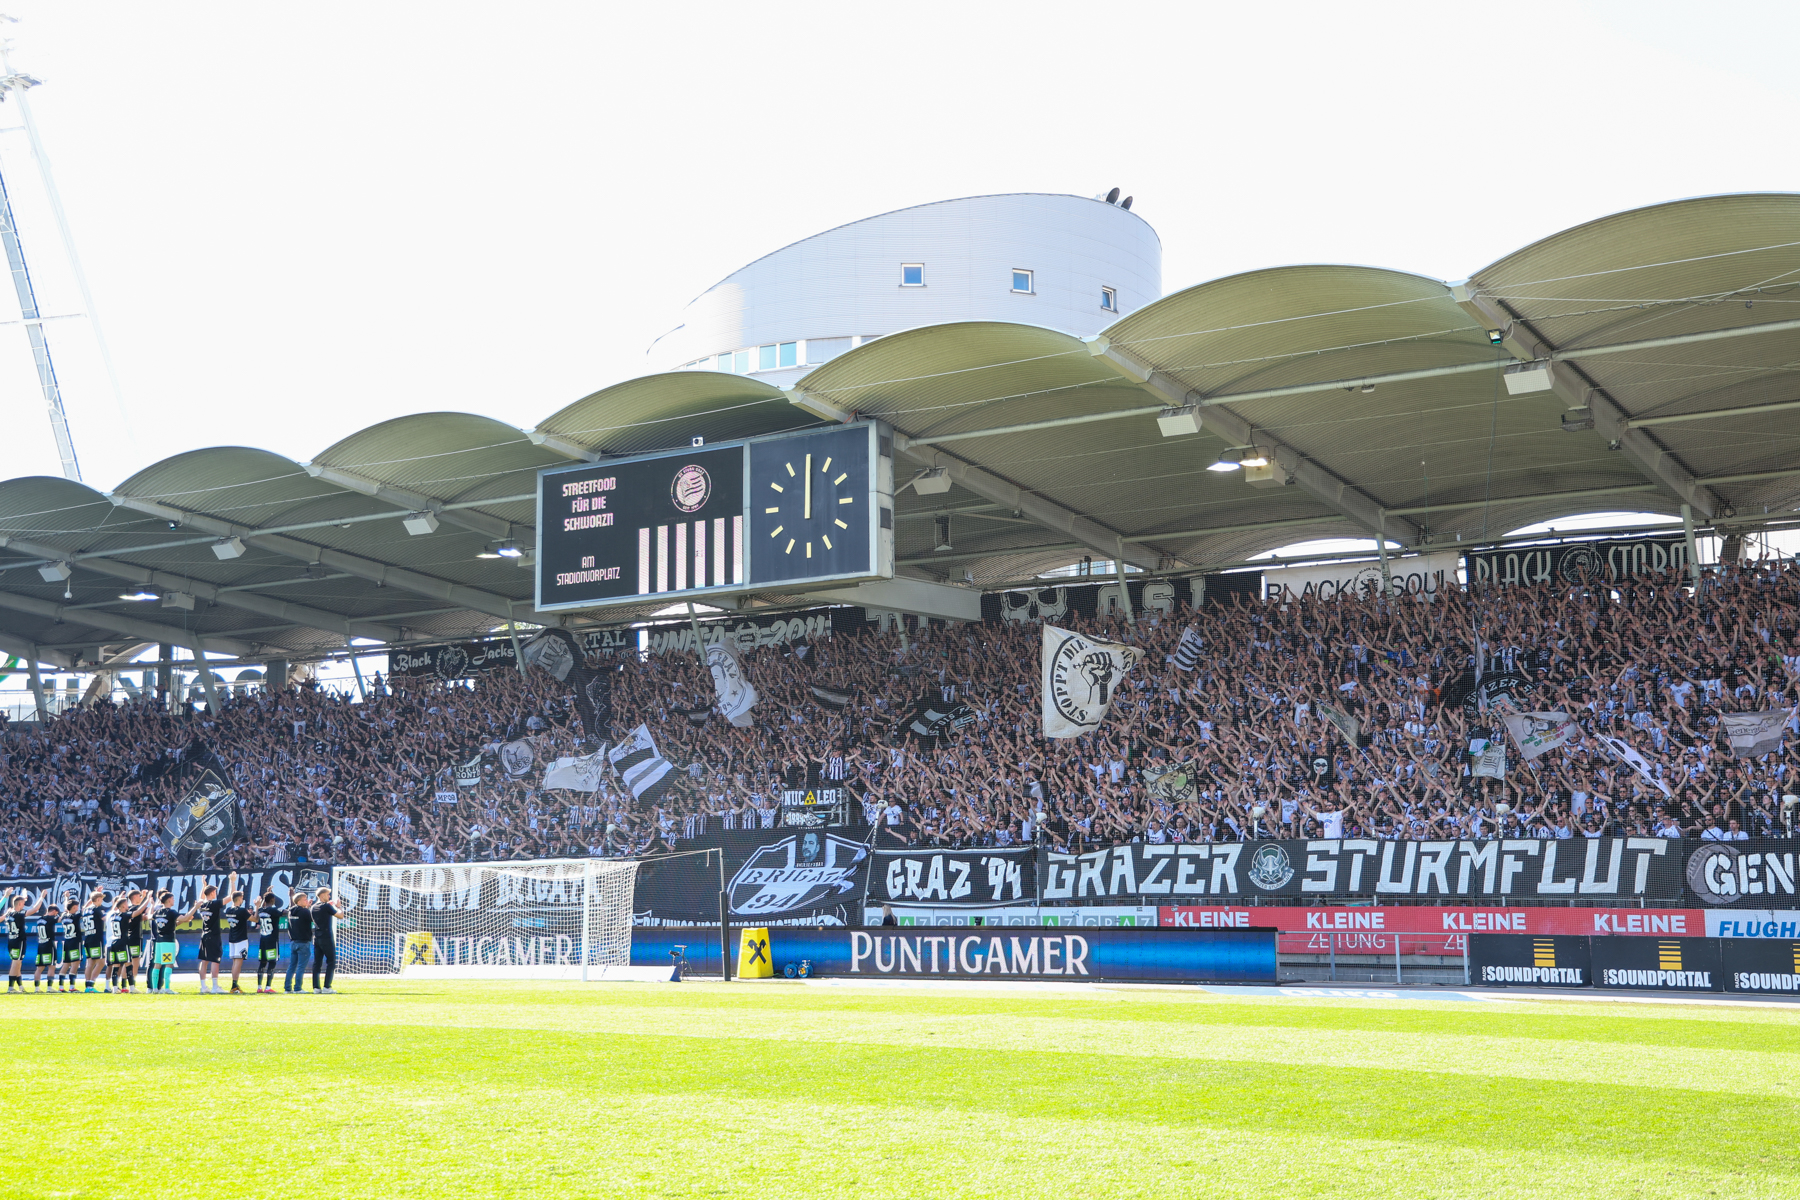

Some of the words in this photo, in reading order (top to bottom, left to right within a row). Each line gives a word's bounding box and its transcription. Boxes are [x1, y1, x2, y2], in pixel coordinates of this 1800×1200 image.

[562, 477, 616, 497] STREETFOOD
[572, 498, 590, 513] FÜR
[592, 495, 606, 511] DIE
[582, 555, 595, 568] AM
[557, 567, 621, 586] STADIONVORPLATZ
[393, 653, 432, 672] Black
[472, 643, 515, 666] Jacks
[886, 854, 972, 900] GRAZ
[980, 857, 1022, 900] '94
[1043, 842, 1244, 899] GRAZER
[1302, 838, 1668, 894] STURMFLUT
[1704, 853, 1800, 895] GEN
[83, 915, 94, 932] 35
[938, 918, 1000, 926] GRZ
[1174, 911, 1249, 926] KLEINE
[1307, 912, 1385, 929] KLEINE
[1442, 912, 1527, 930] KLEINE
[1594, 913, 1687, 933] KLEINE
[1719, 920, 1800, 938] FLUGH
[395, 933, 573, 966] PNTIGAMER
[1307, 933, 1385, 949] ZETUNG
[850, 931, 1089, 975] PUNTIGAMER
[1486, 966, 1583, 984] SOUNDPORTAL
[1608, 969, 1712, 987] SOUNDPORTAL
